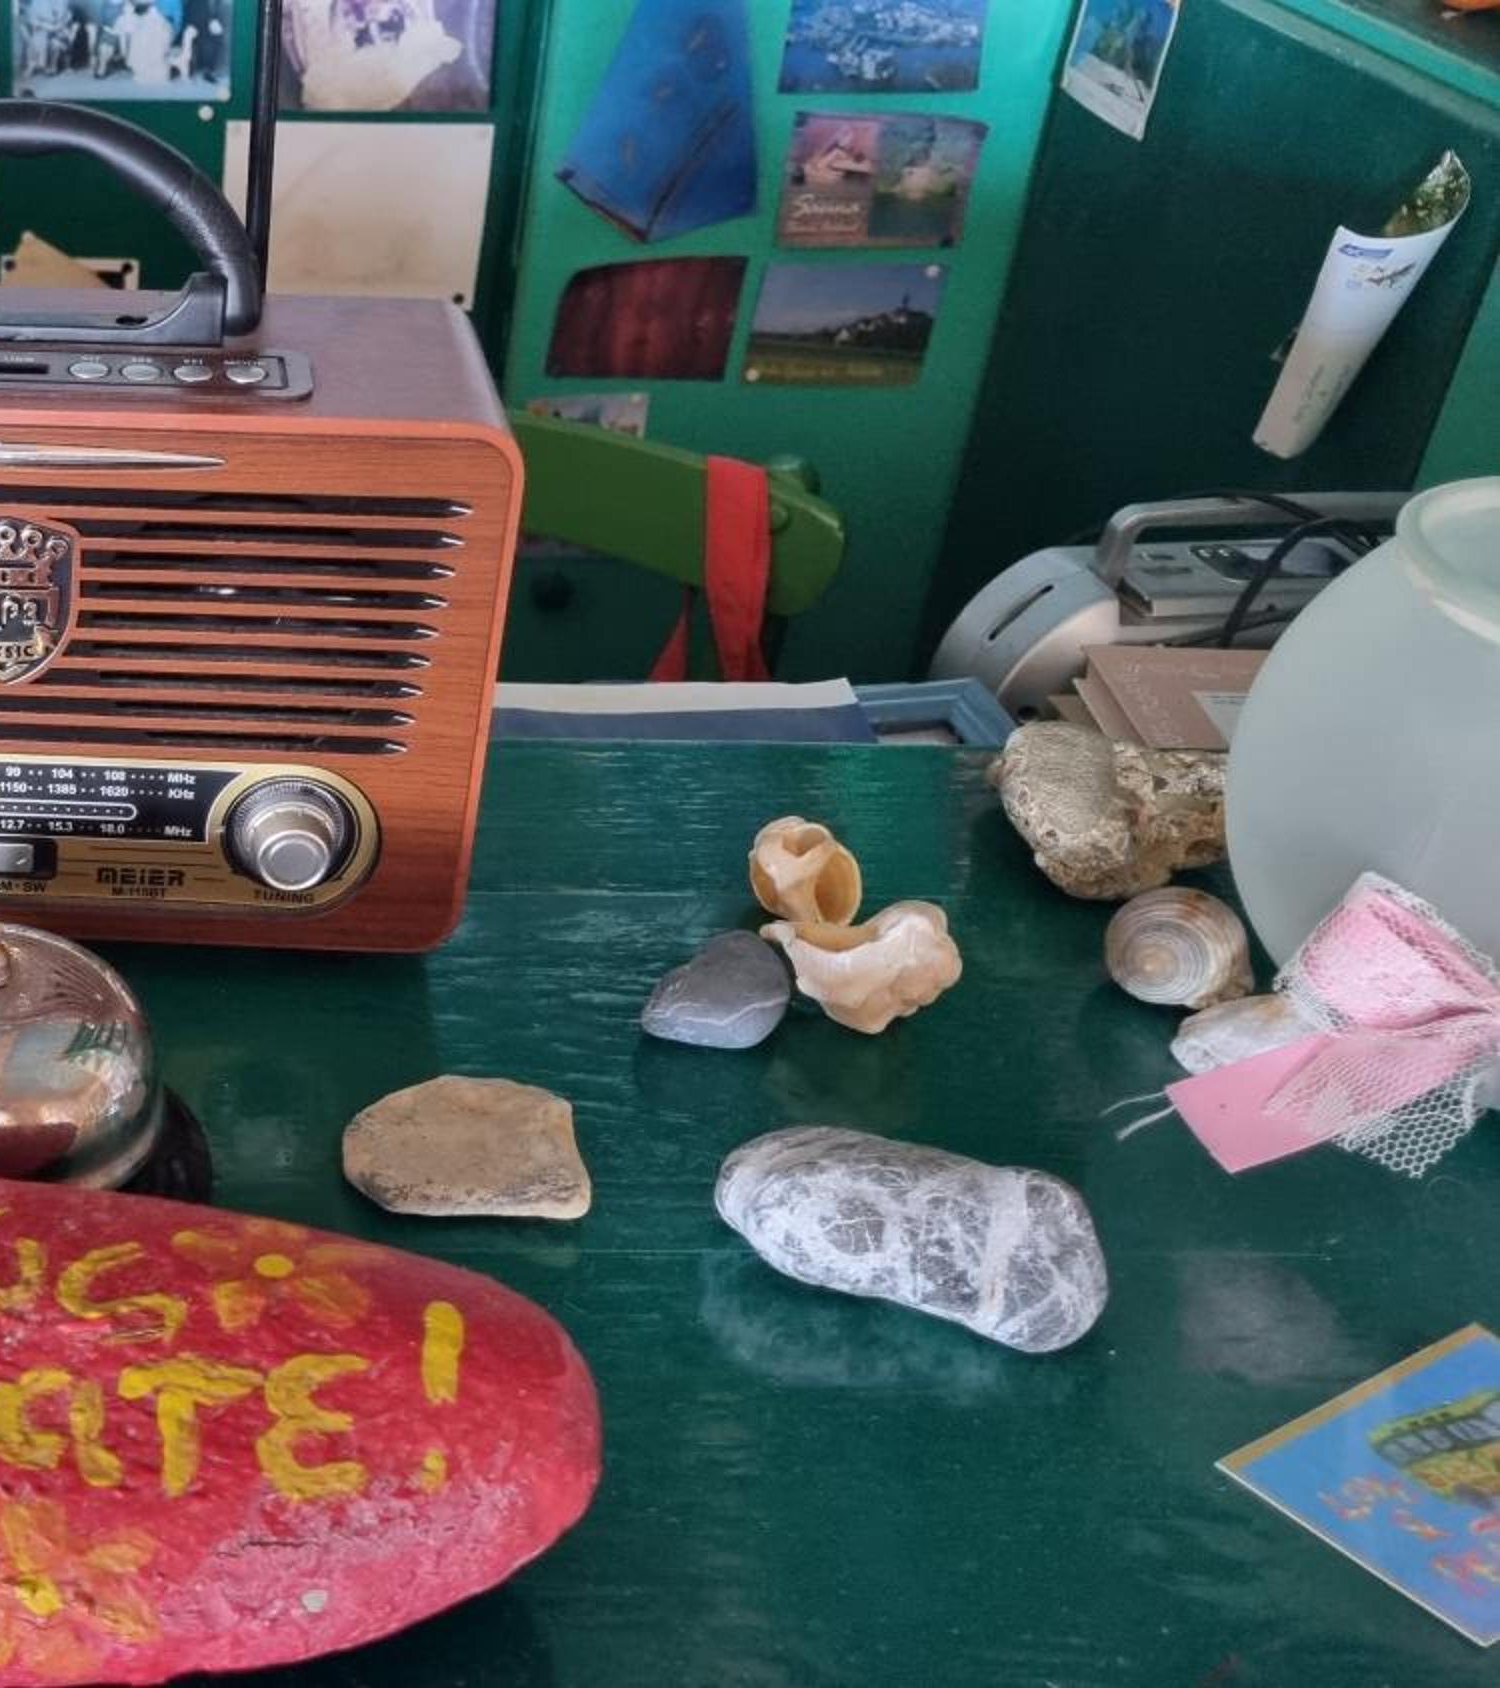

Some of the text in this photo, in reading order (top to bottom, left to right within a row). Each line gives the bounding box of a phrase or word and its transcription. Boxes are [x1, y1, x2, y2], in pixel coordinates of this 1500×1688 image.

[52, 768, 73, 779] 104
[167, 773, 196, 785] MHz
[0, 781, 27, 793] 1150
[49, 784, 77, 795] 1385
[168, 788, 195, 800] KHz
[0, 819, 25, 830] 12.7
[49, 821, 73, 832] 15.3
[163, 825, 192, 837] MHz
[97, 867, 186, 887] MEIER
[254, 889, 315, 904] TUNING
